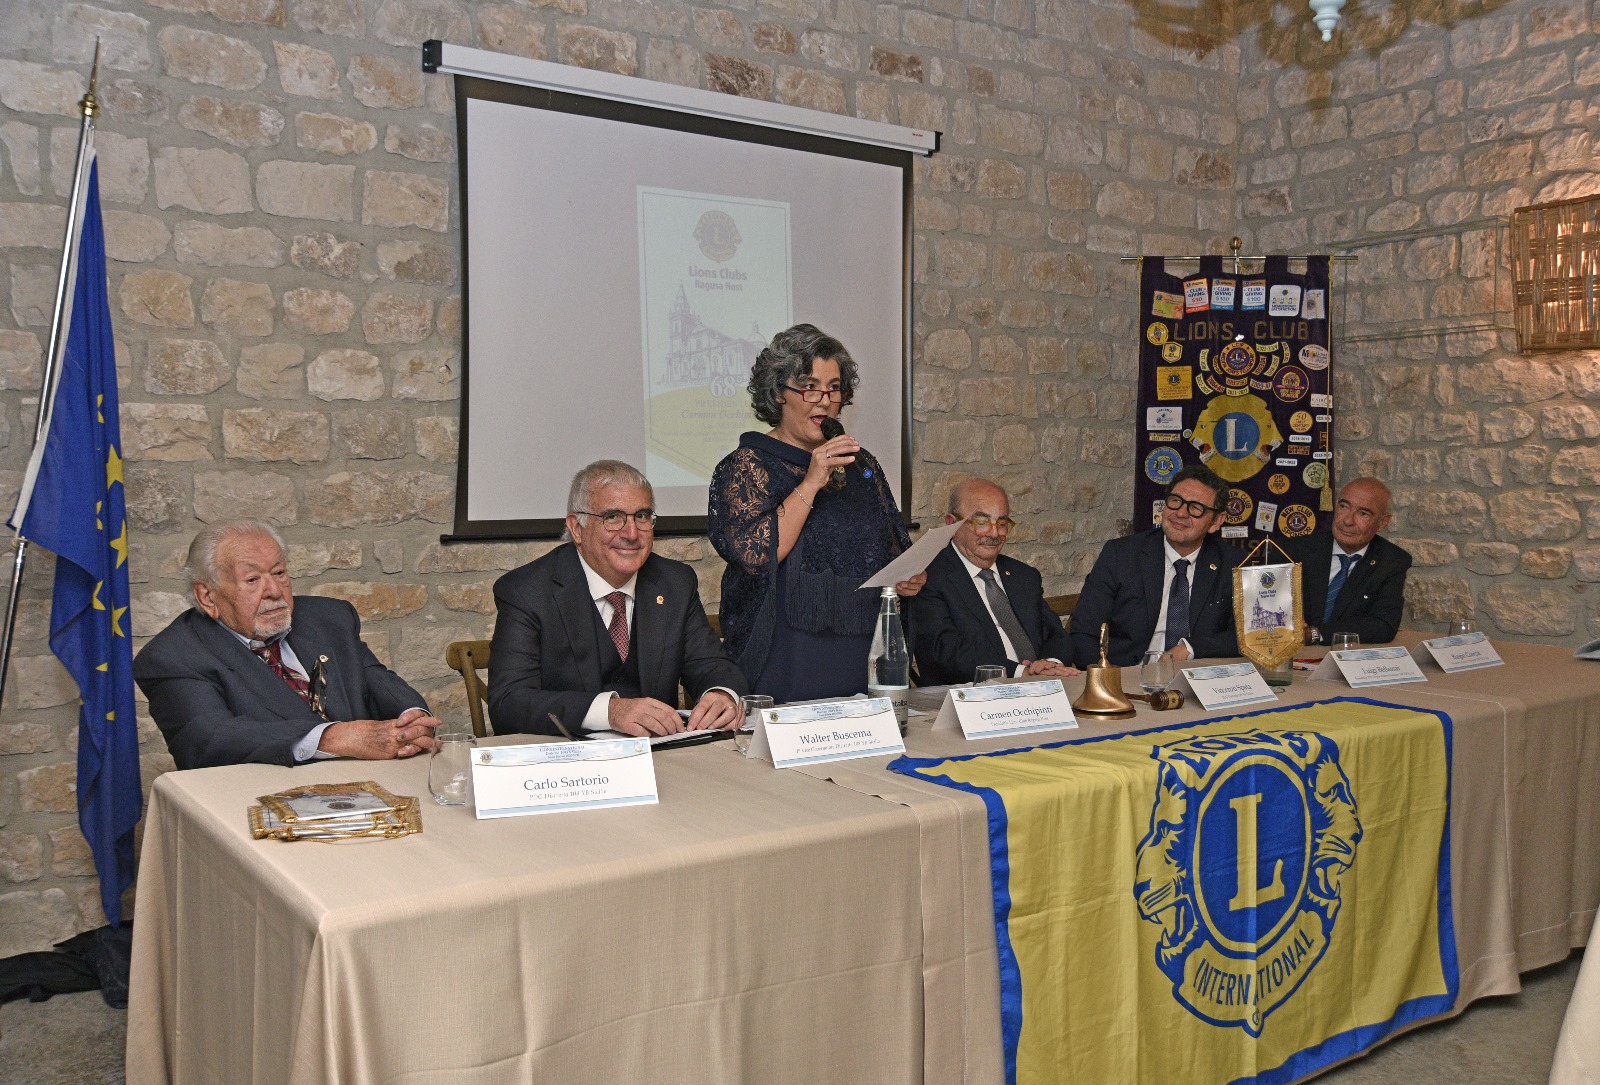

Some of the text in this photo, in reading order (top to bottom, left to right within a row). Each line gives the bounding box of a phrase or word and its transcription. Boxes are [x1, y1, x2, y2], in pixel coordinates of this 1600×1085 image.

[688, 265, 748, 281] Lions Clubs
[694, 280, 743, 291] Ragusa Host
[1174, 320, 1309, 340] LIONS CLUB
[1225, 418, 1248, 452] L
[1273, 475, 1284, 483] 25
[1281, 506, 1294, 518] NEW
[1297, 506, 1313, 518] CLUB
[980, 705, 1053, 721] Carmen Occhipinti
[800, 730, 872, 745] Walter Buscema
[1168, 732, 1310, 779] LIONS
[523, 774, 609, 791] Carlo Sartorio
[1229, 792, 1285, 912] L
